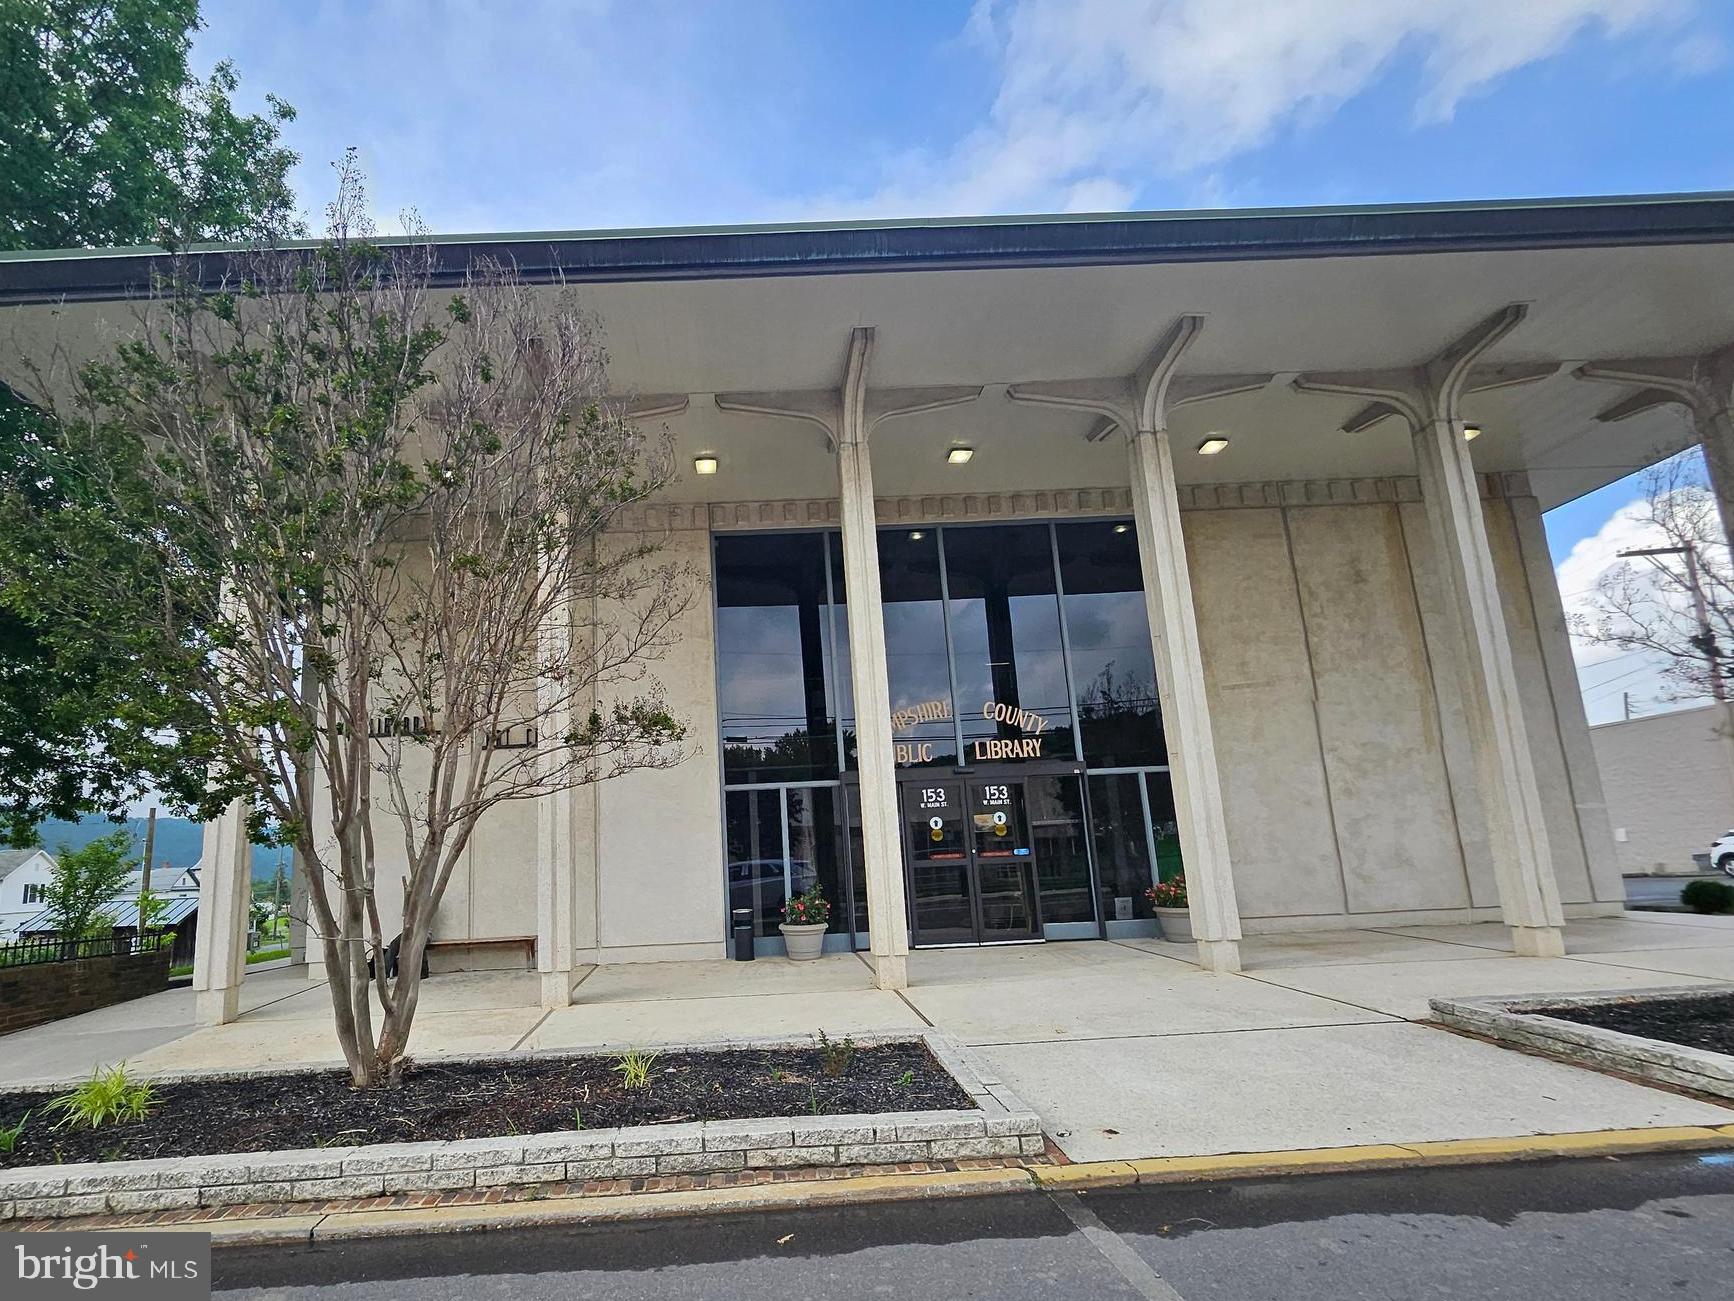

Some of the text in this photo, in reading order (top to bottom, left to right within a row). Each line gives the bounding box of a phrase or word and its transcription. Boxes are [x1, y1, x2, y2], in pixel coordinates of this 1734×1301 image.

[891, 701, 1048, 735] MPSHIRE COUNTY
[895, 738, 1042, 762] BLIC LIBRARY
[921, 788, 946, 802] 153
[985, 785, 1008, 800] 153
